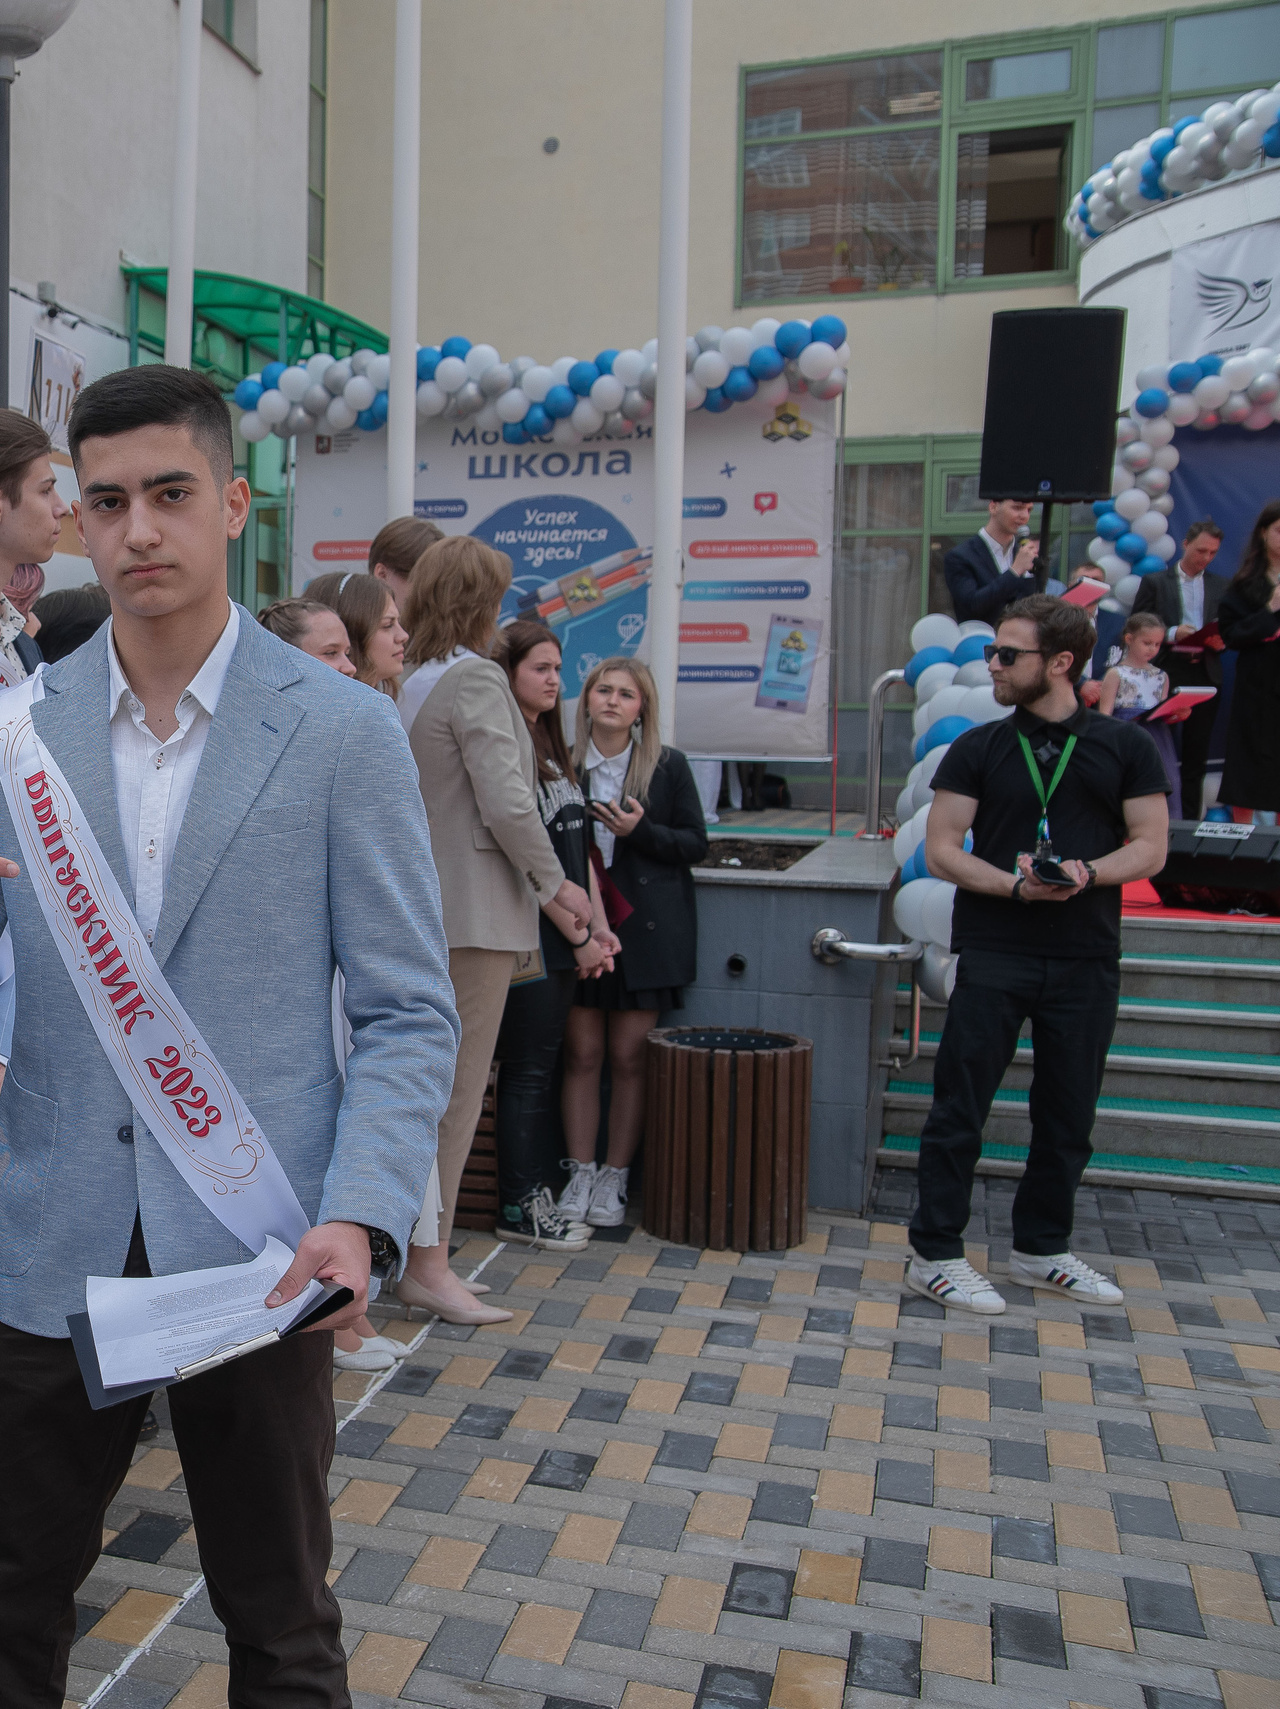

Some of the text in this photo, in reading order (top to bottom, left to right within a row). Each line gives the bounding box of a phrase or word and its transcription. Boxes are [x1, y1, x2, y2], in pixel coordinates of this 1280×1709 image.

[468, 450, 632, 480] школа
[523, 508, 579, 526] Успех
[494, 527, 608, 544] начинается
[523, 543, 583, 568] здесь!
[24, 770, 222, 1138] ВЫПУСКНИК 2023
